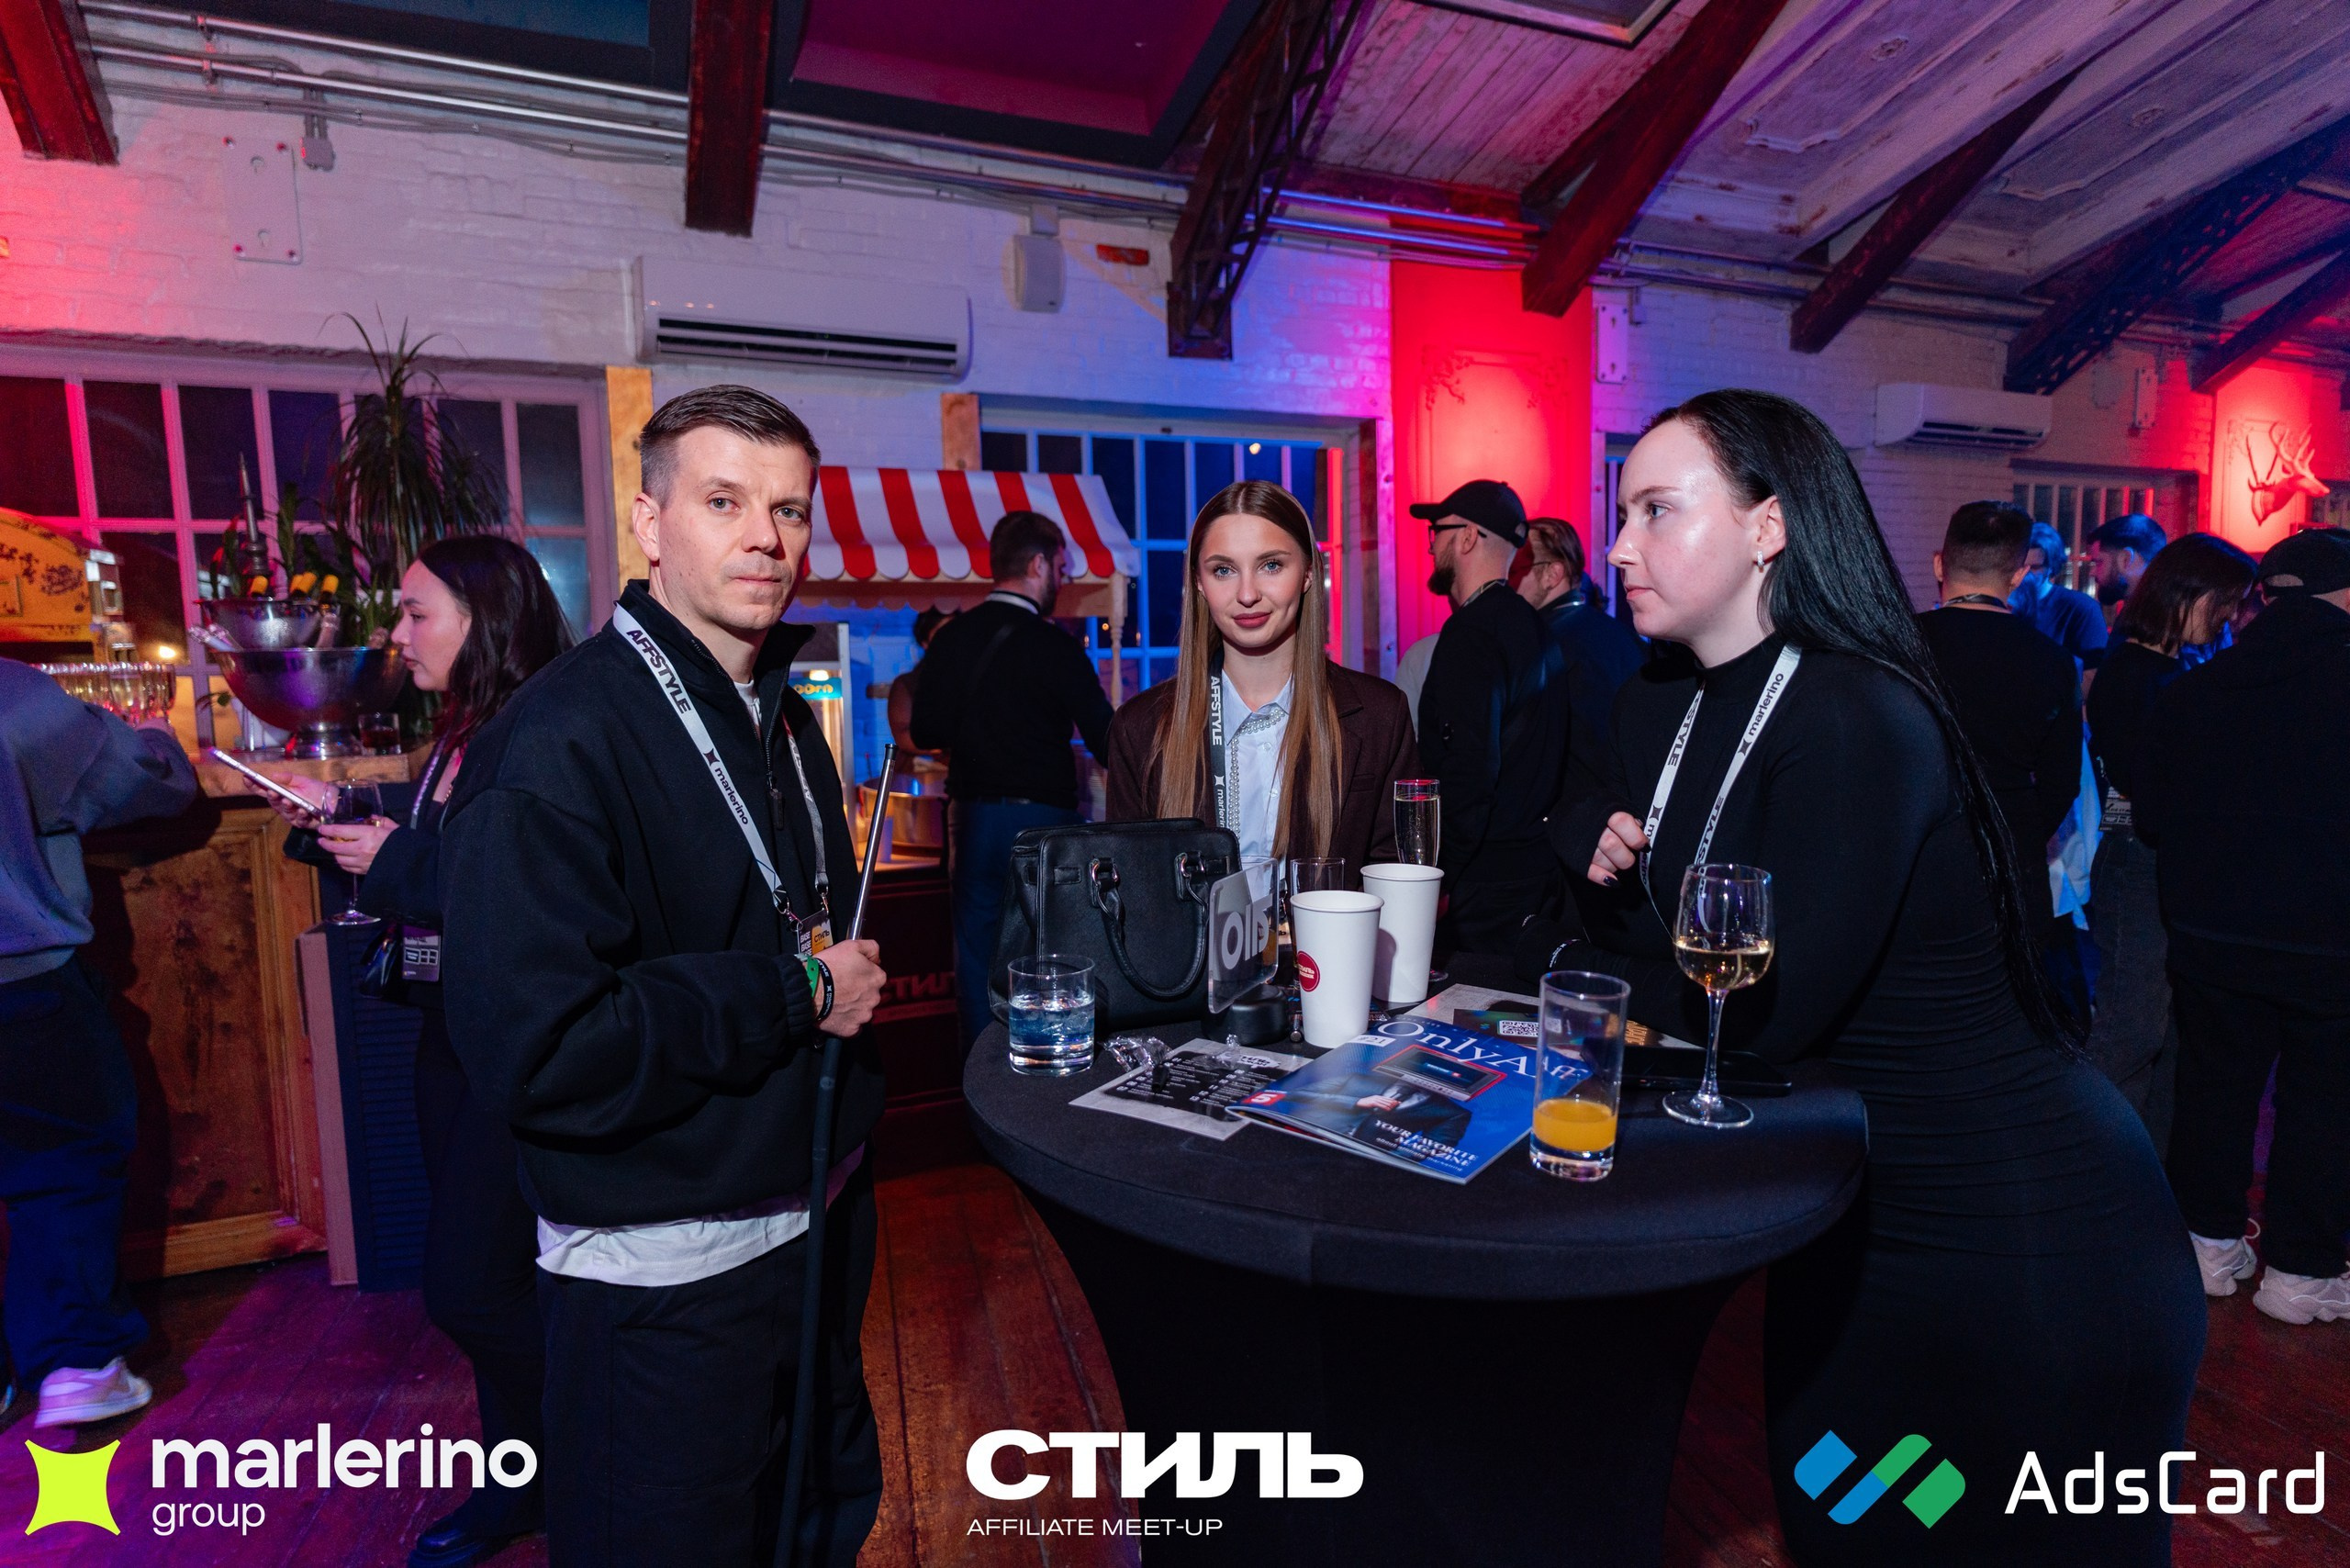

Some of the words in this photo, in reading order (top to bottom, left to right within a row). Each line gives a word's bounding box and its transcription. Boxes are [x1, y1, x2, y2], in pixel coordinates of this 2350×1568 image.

[627, 629, 691, 714] AFFSTYLE
[1210, 676, 1222, 746] AFFSTYLE
[1668, 698, 1699, 767] STYLE
[1748, 672, 1785, 736] marlerino
[714, 767, 749, 825] marlerino
[1376, 1120, 1412, 1138] YOUR
[1412, 1134, 1478, 1161] FAVORITE
[1395, 1137, 1471, 1166] MAGAZINE
